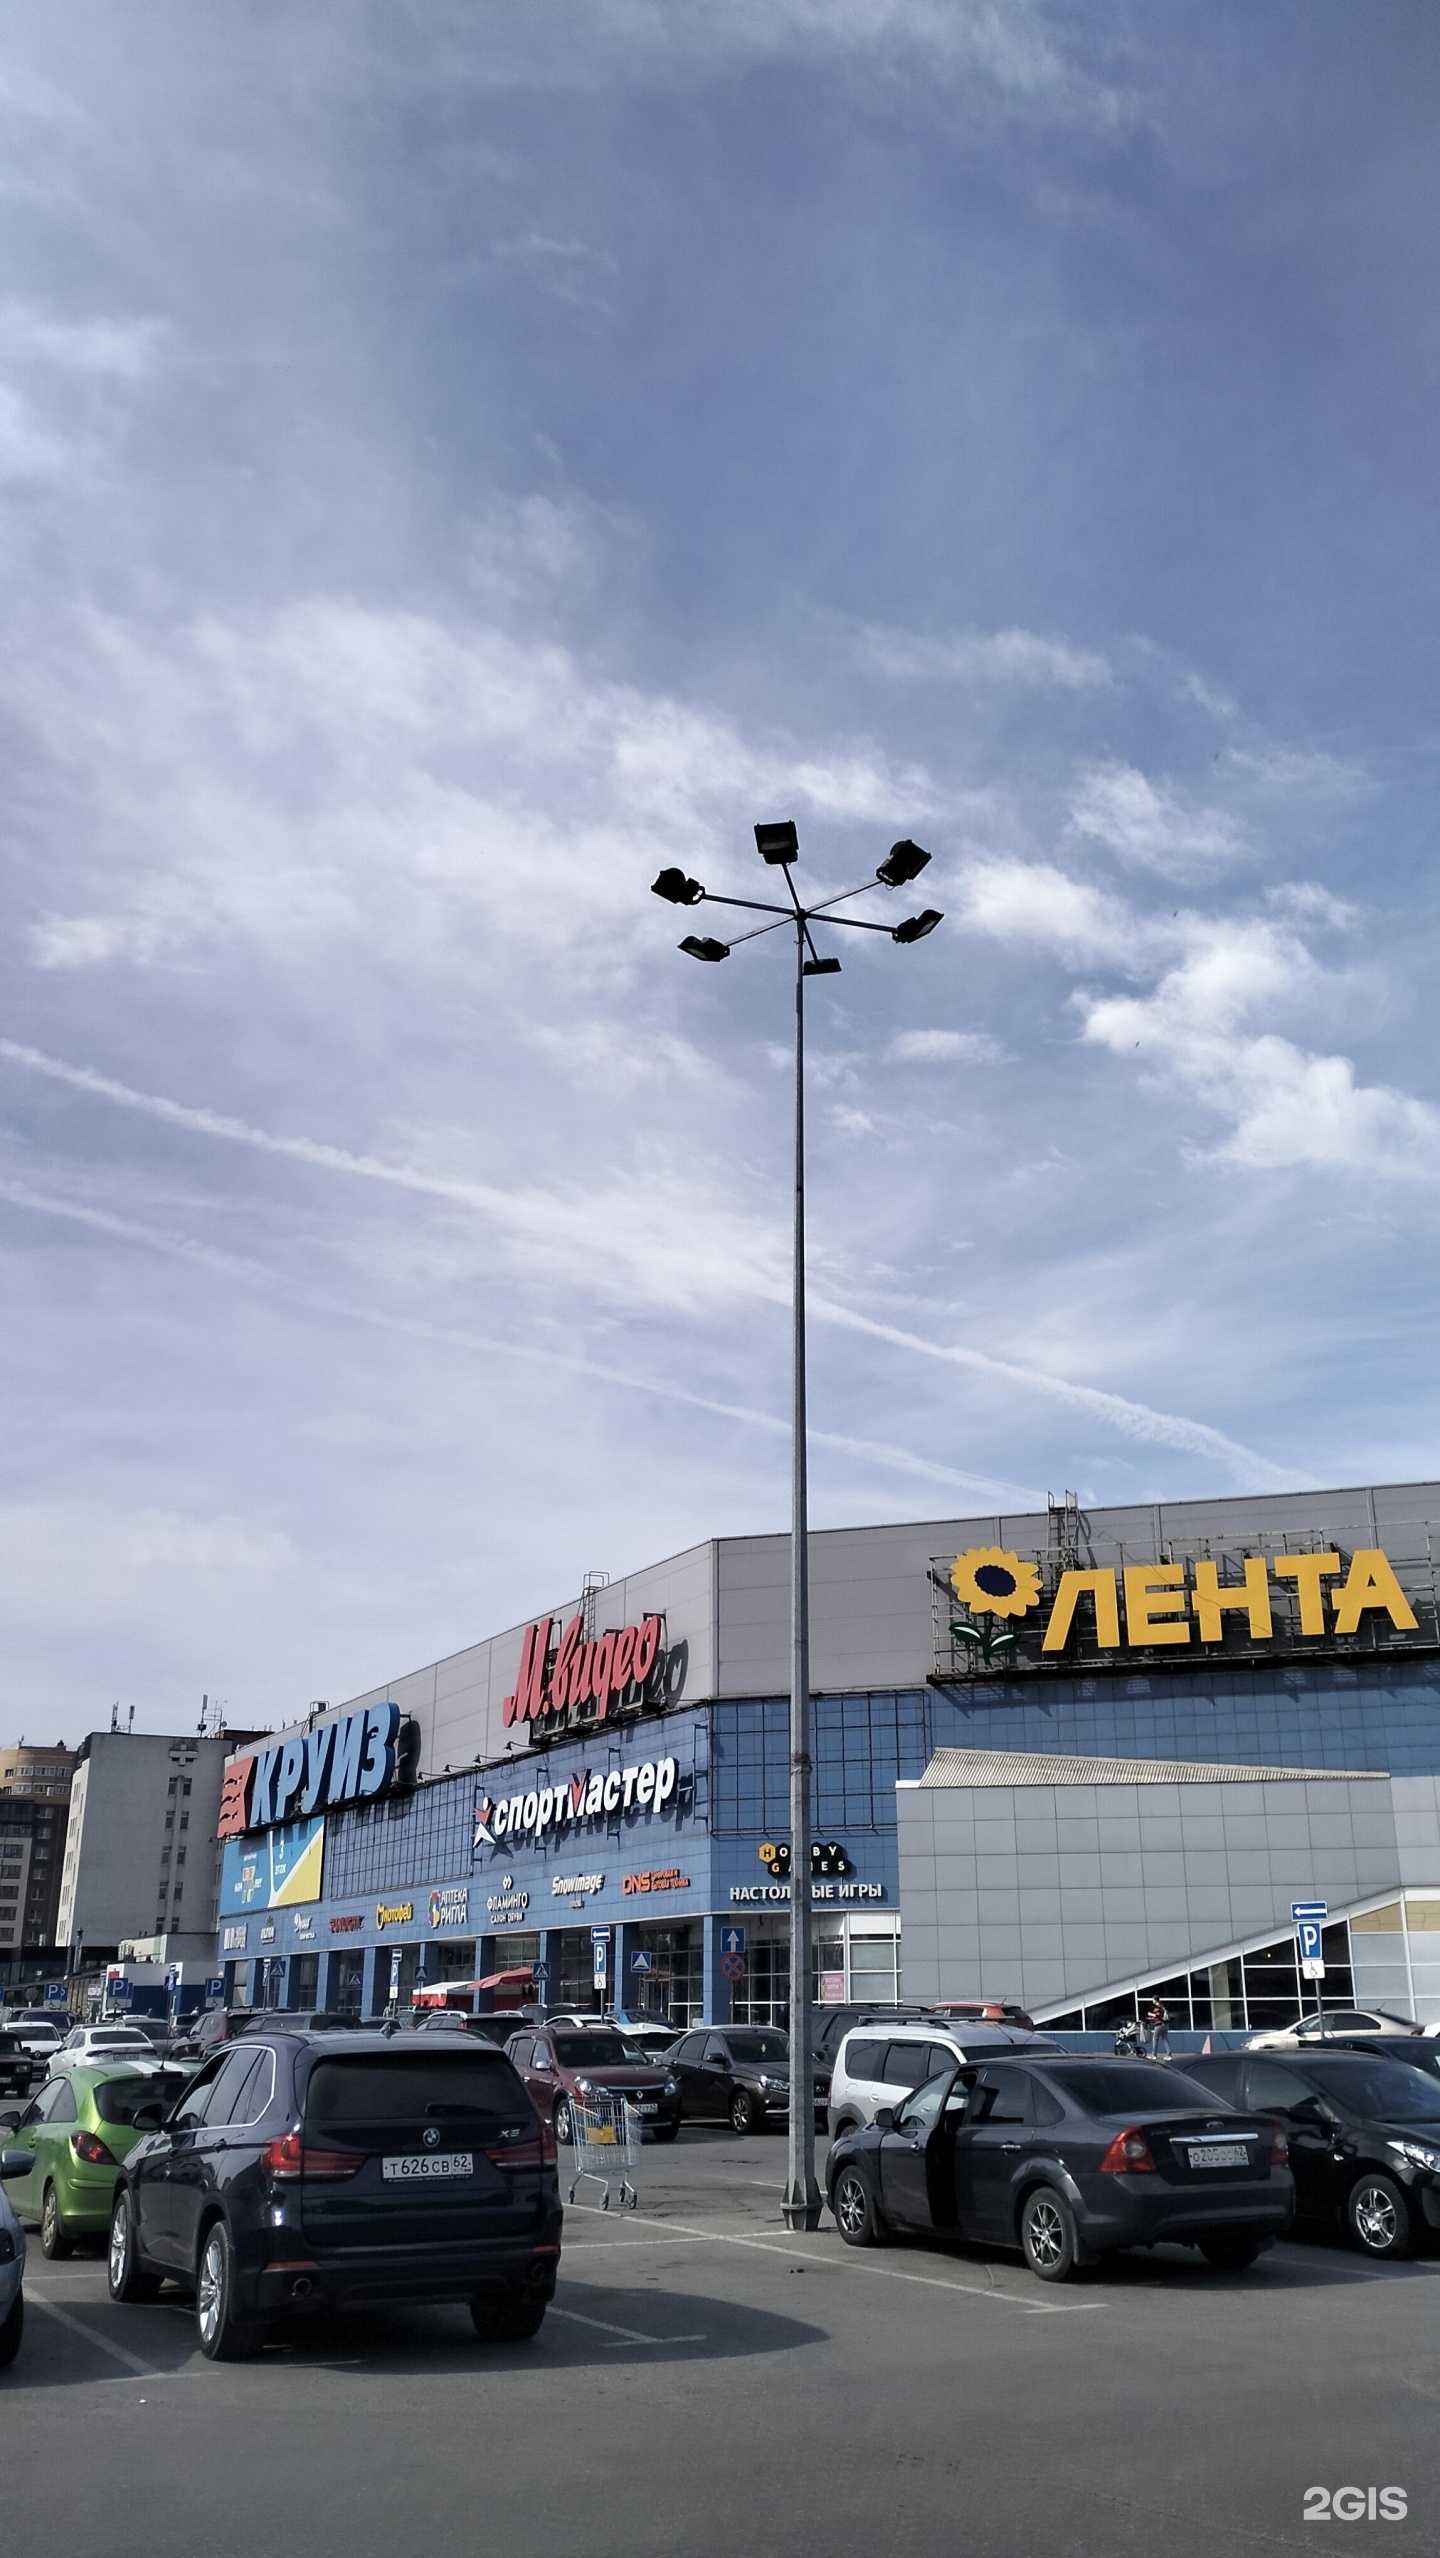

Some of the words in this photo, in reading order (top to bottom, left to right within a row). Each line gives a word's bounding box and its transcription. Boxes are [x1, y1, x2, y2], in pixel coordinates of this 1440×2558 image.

[1042, 1549, 1419, 1652] ЛЕНТА
[250, 1702, 392, 1827] КРУИЗ
[763, 1846, 838, 1858] HOBY
[771, 1861, 846, 1873] GES
[624, 1872, 651, 1895] DNS
[730, 1885, 834, 1900] НАСТОЛЫЕ
[839, 1884, 882, 1898] ИГРЫ
[440, 1888, 468, 1905] АПТЕКА
[487, 1892, 528, 1911] ФЛАМИНГО
[440, 1904, 468, 1925] РИГЛА
[1302, 1925, 1318, 1956] P
[596, 1946, 604, 1971] P
[48, 1984, 58, 1998] P
[112, 1980, 124, 1996] P
[211, 1980, 222, 1996] P
